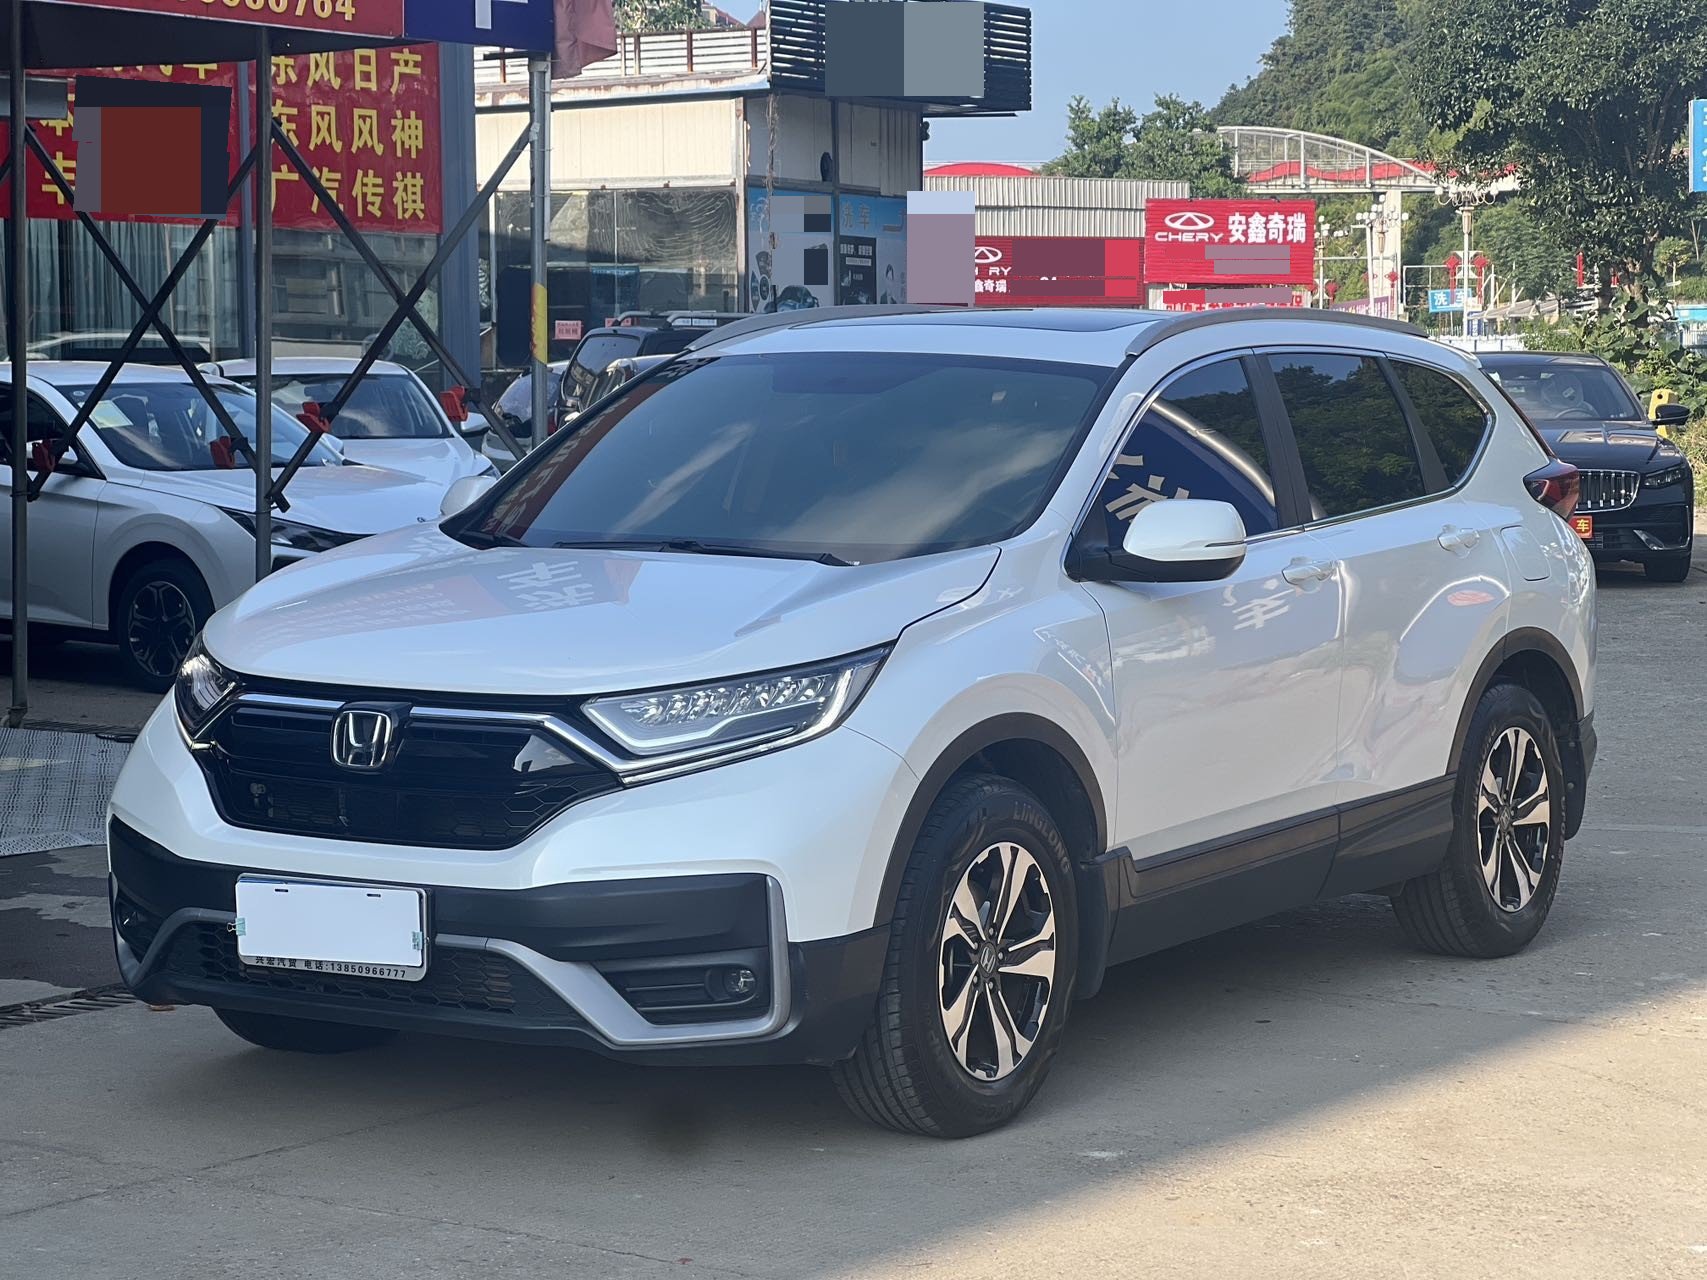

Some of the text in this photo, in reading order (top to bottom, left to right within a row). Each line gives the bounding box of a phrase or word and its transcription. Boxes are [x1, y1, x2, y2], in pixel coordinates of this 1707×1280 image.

[271, 99, 424, 159] 东风风神
[1155, 232, 1224, 242] CHERY
[1228, 212, 1306, 243] 安鑫奇瑞
[1576, 518, 1589, 532] 车
